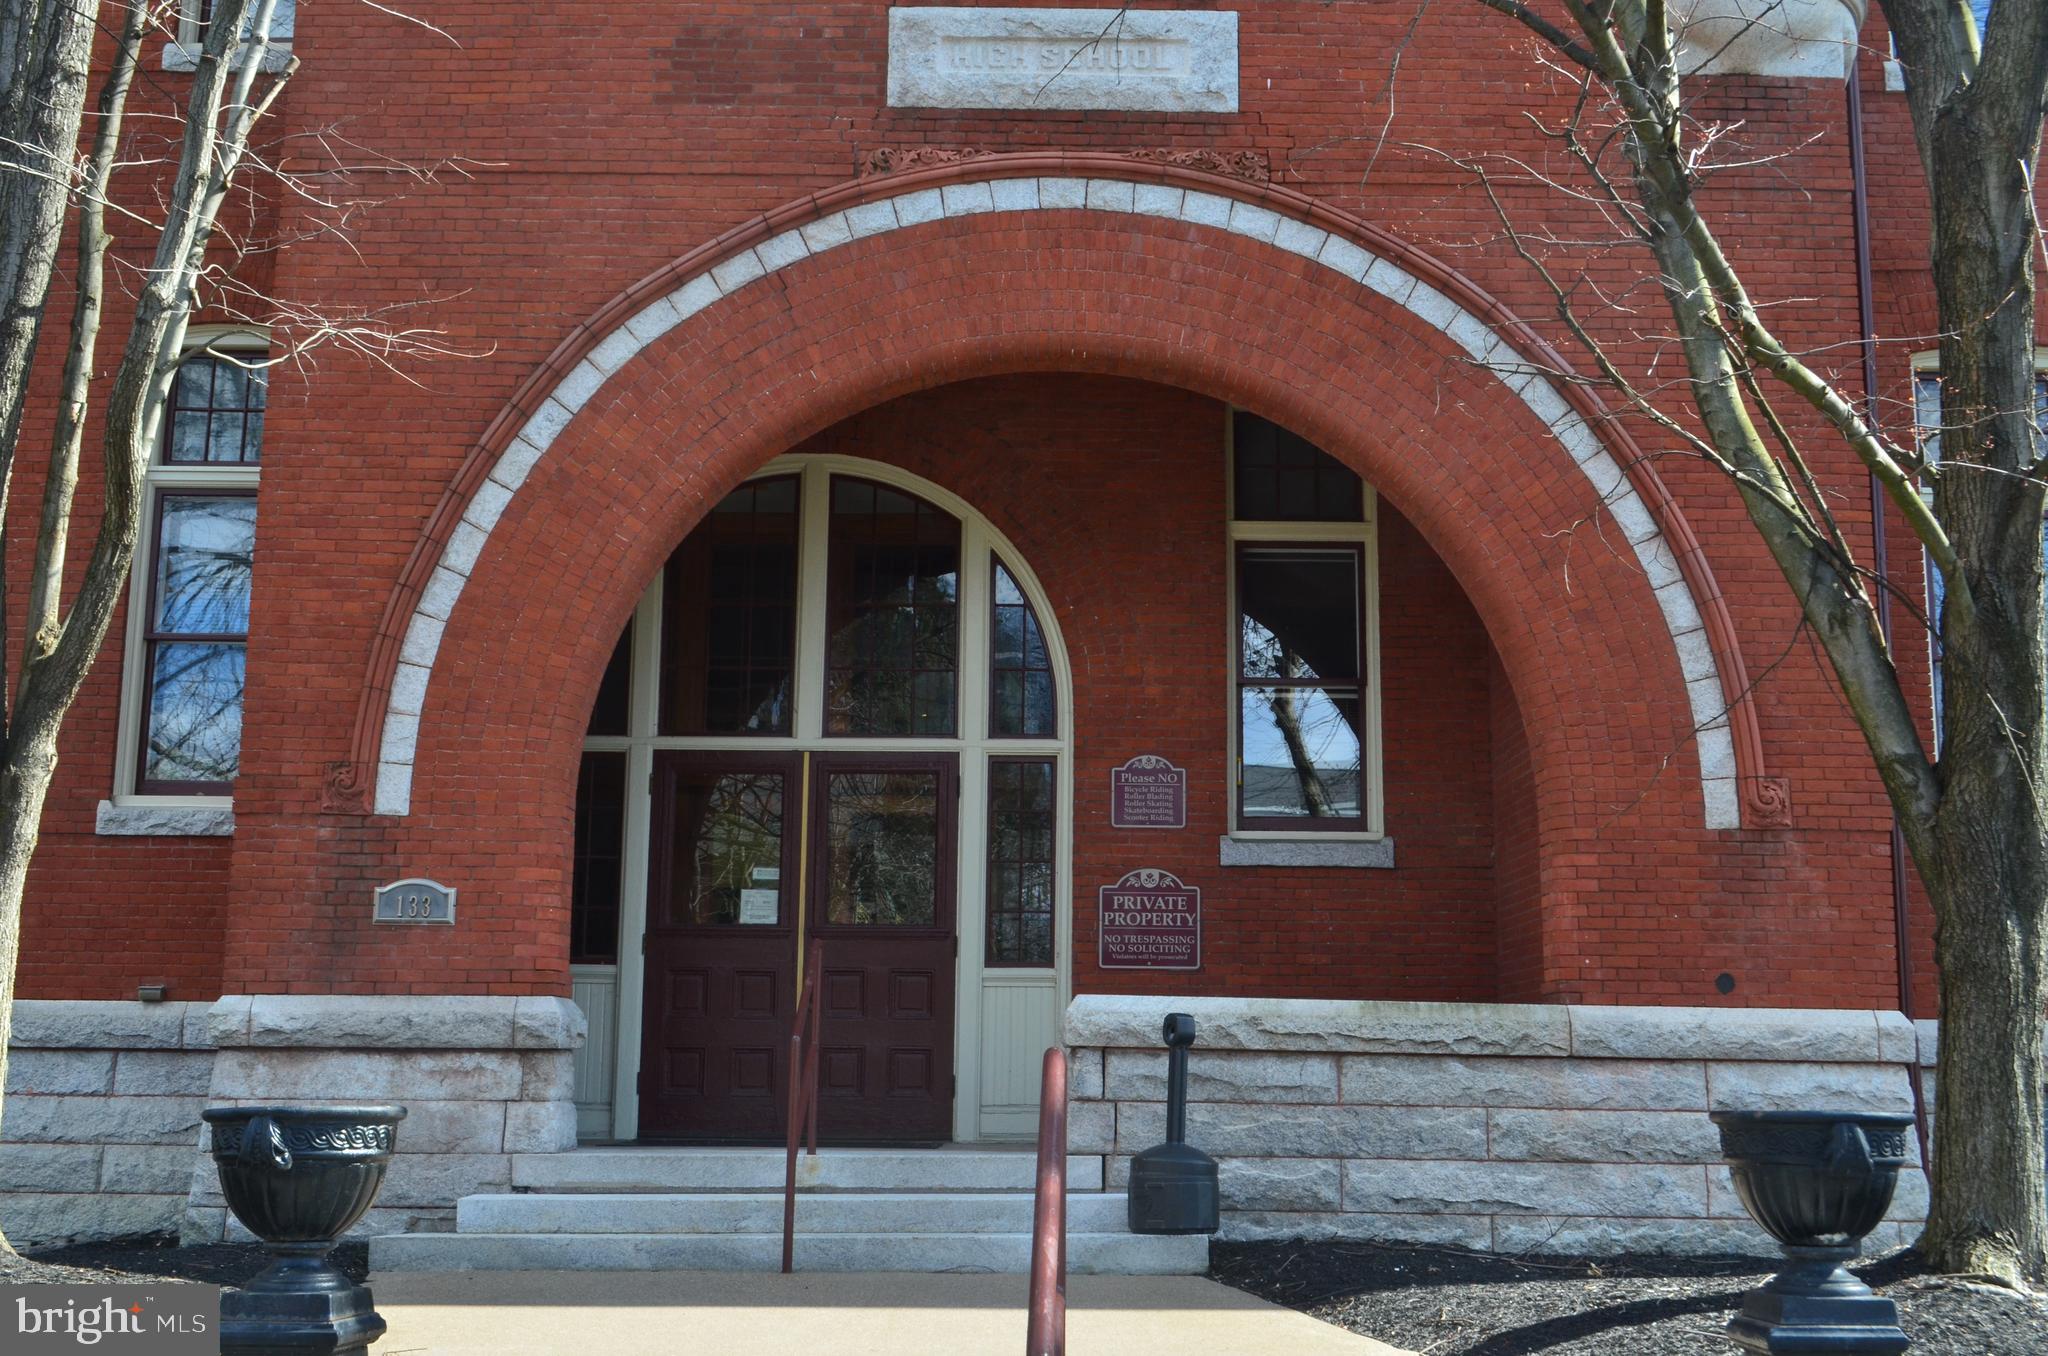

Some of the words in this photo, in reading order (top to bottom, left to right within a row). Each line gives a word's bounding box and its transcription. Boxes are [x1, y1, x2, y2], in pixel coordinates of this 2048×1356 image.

[951, 48, 1028, 70] HIGH
[1040, 48, 1171, 71] SCHOOL
[1121, 773, 1155, 783] Please
[1158, 773, 1178, 783] NO
[1124, 786, 1149, 794] Bicycle
[1150, 786, 1174, 794] Riding
[1147, 793, 1174, 801] Blading
[1147, 800, 1174, 808] Skating
[1123, 807, 1174, 815] Skateboarding
[1150, 814, 1174, 822] Riding
[397, 895, 431, 917] 133
[1112, 895, 1188, 910] PRIVATE
[1103, 911, 1196, 927] PROPERTY
[1104, 934, 1121, 943] NO
[1123, 935, 1196, 944] TRESPASSING
[1108, 944, 1125, 952] NO
[1128, 944, 1191, 953] SOLICITING
